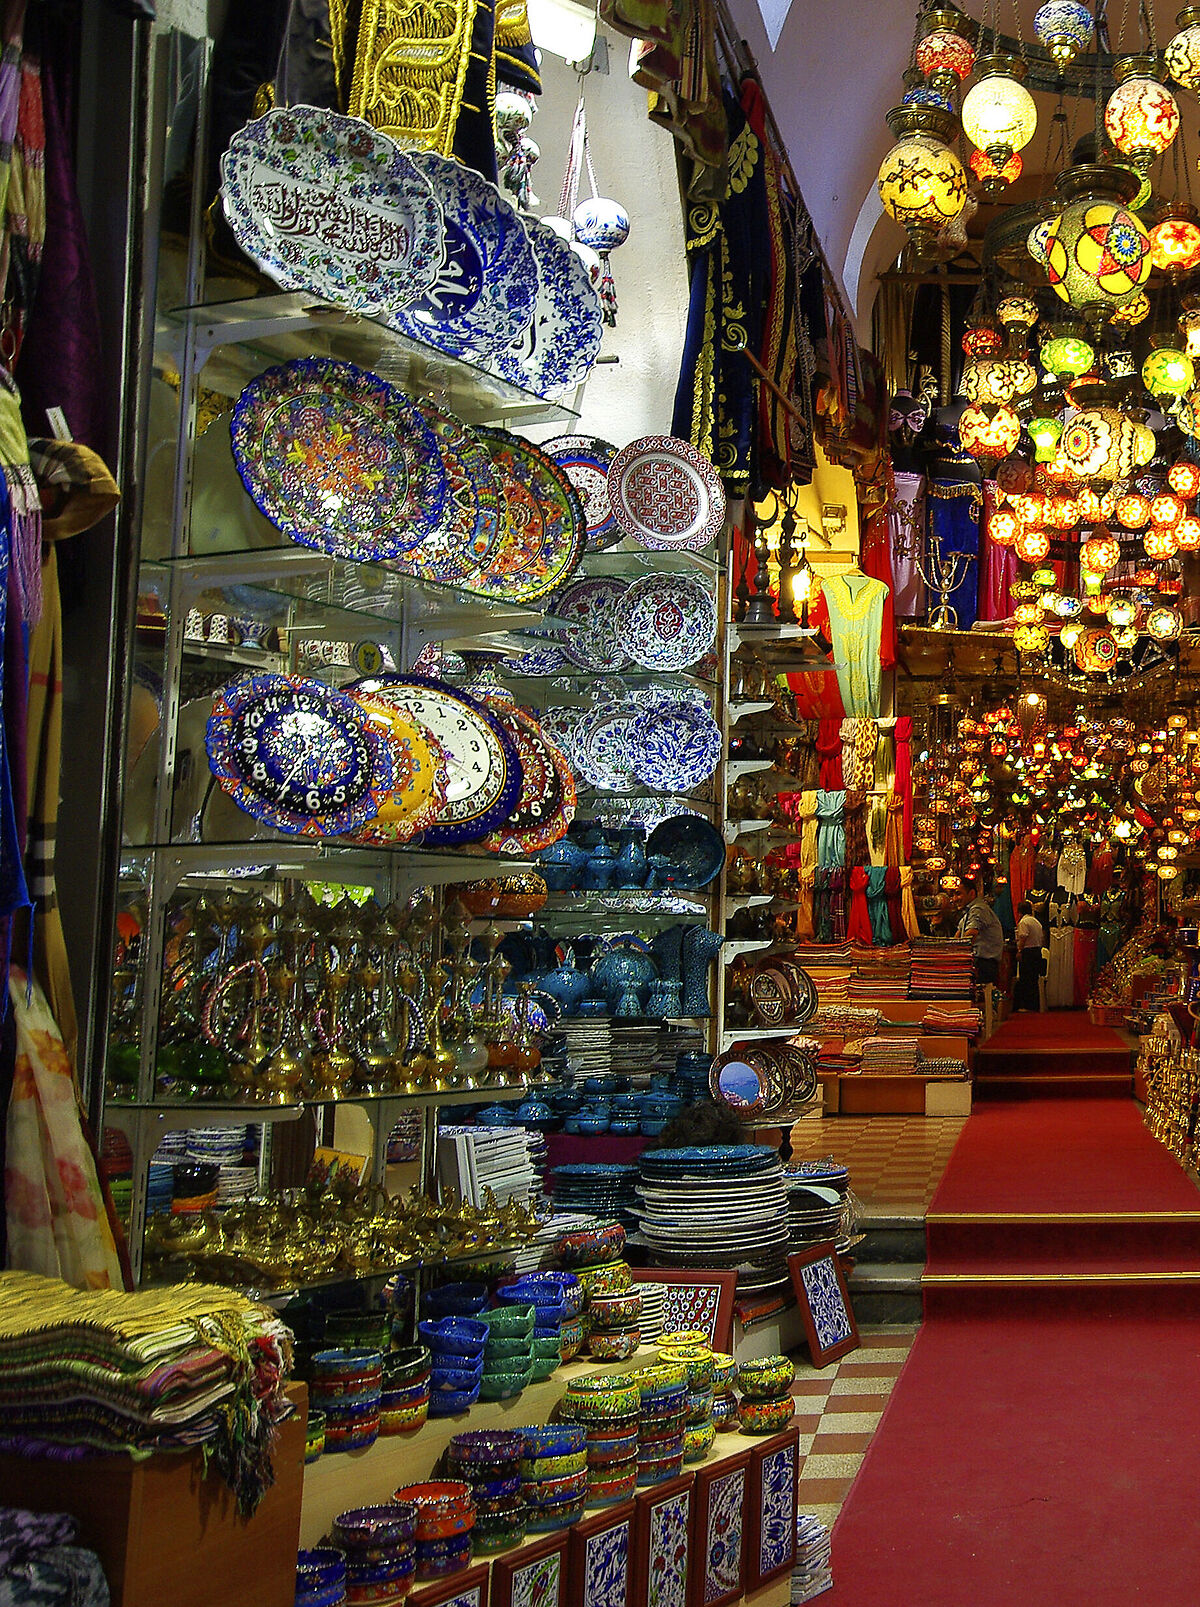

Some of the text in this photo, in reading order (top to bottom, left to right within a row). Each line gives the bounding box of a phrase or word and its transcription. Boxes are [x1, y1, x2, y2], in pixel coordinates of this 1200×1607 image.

[264, 697, 280, 713] 11
[292, 694, 311, 711] 12
[404, 701, 425, 714] 12
[326, 703, 334, 718] 1
[437, 707, 447, 718] 1
[243, 711, 264, 728] 10
[456, 720, 469, 732] 2
[509, 716, 519, 730] 1
[346, 723, 359, 738] 2
[243, 737, 258, 754] 9
[403, 738, 413, 751] 2
[470, 740, 480, 752] 3
[531, 739, 546, 754] 2
[356, 747, 368, 764] 3
[252, 762, 266, 780] 8
[411, 759, 421, 773] 3
[472, 762, 484, 773] 4
[544, 760, 555, 777] 3
[353, 770, 363, 785] 4
[306, 790, 320, 809] 6
[333, 786, 346, 802] 5
[392, 792, 402, 805] 5
[543, 786, 554, 799] 4
[530, 801, 542, 816] 5
